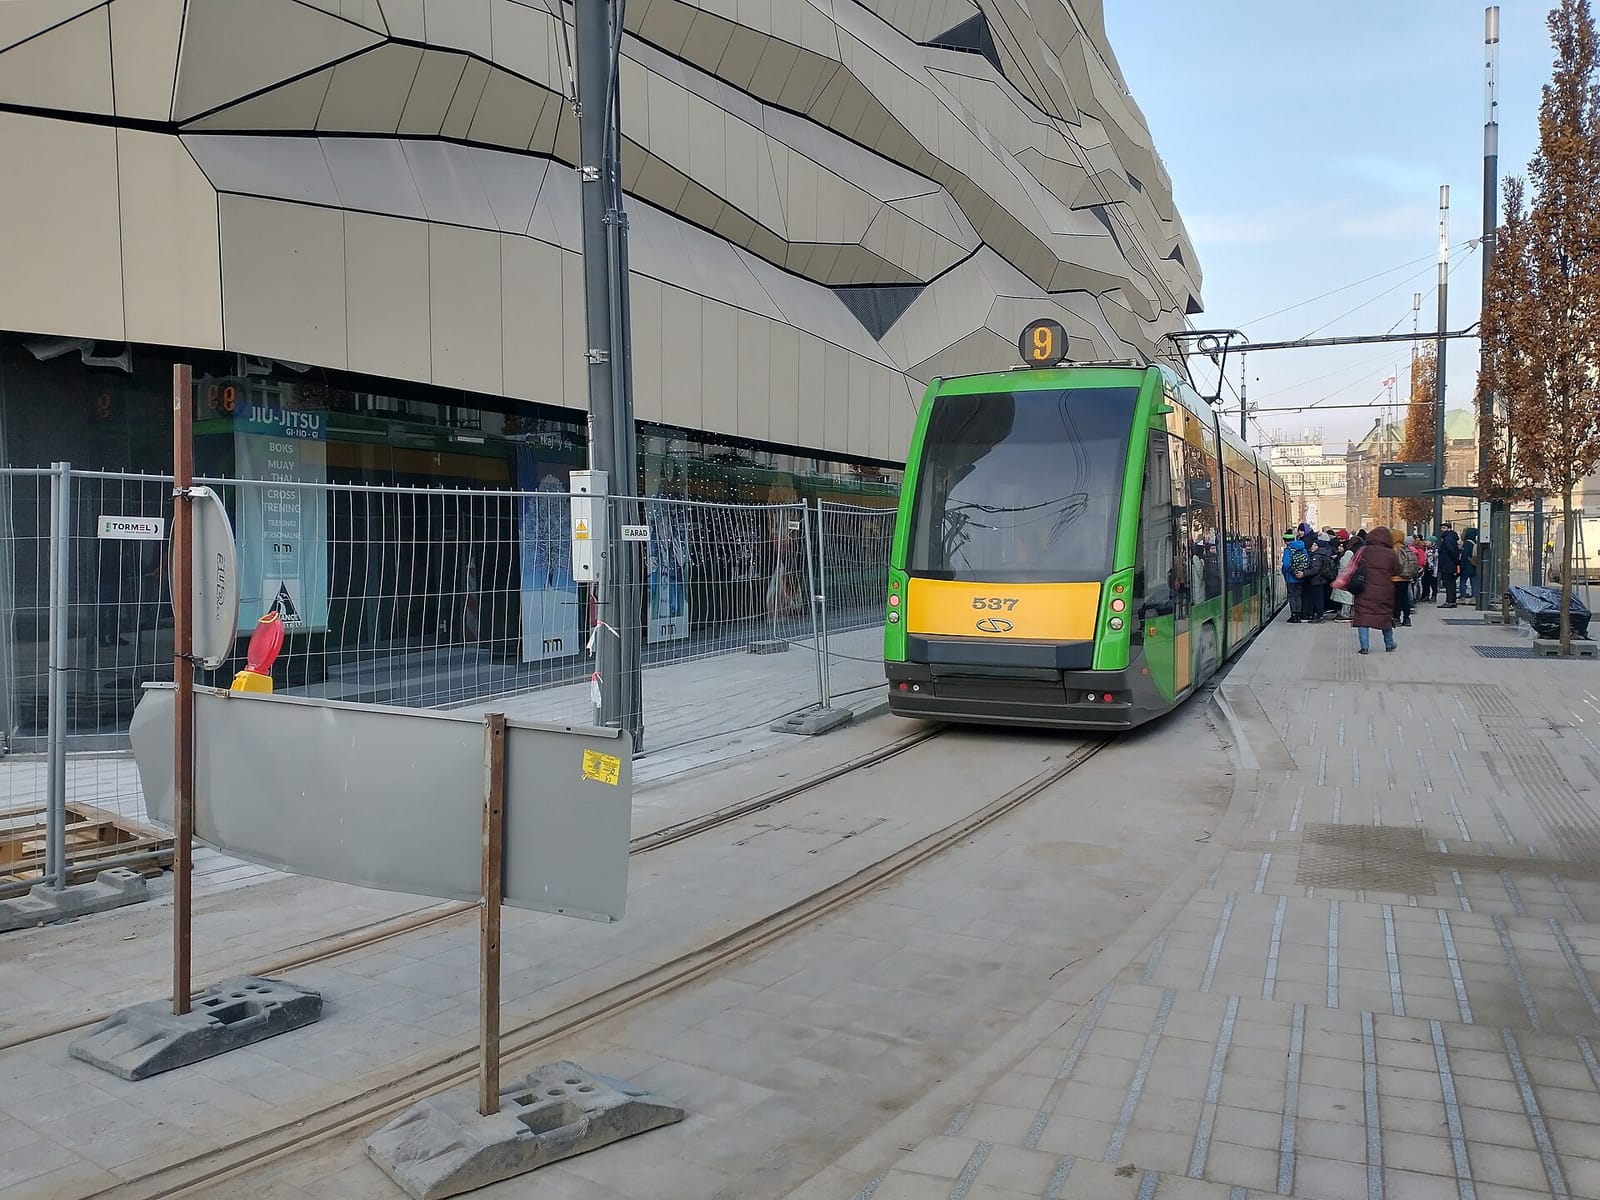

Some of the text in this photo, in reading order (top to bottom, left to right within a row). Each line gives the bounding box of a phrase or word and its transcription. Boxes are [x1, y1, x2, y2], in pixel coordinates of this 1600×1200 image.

[1033, 327, 1052, 360] 9
[249, 406, 319, 429] JIU-JITSU
[269, 442, 294, 454] BOKS
[267, 460, 295, 471] MUAY
[267, 489, 296, 500] CROSS
[263, 503, 301, 513] TRENING
[112, 523, 151, 531] TORMEL
[630, 529, 648, 537] ARAD
[972, 597, 1019, 611] 537
